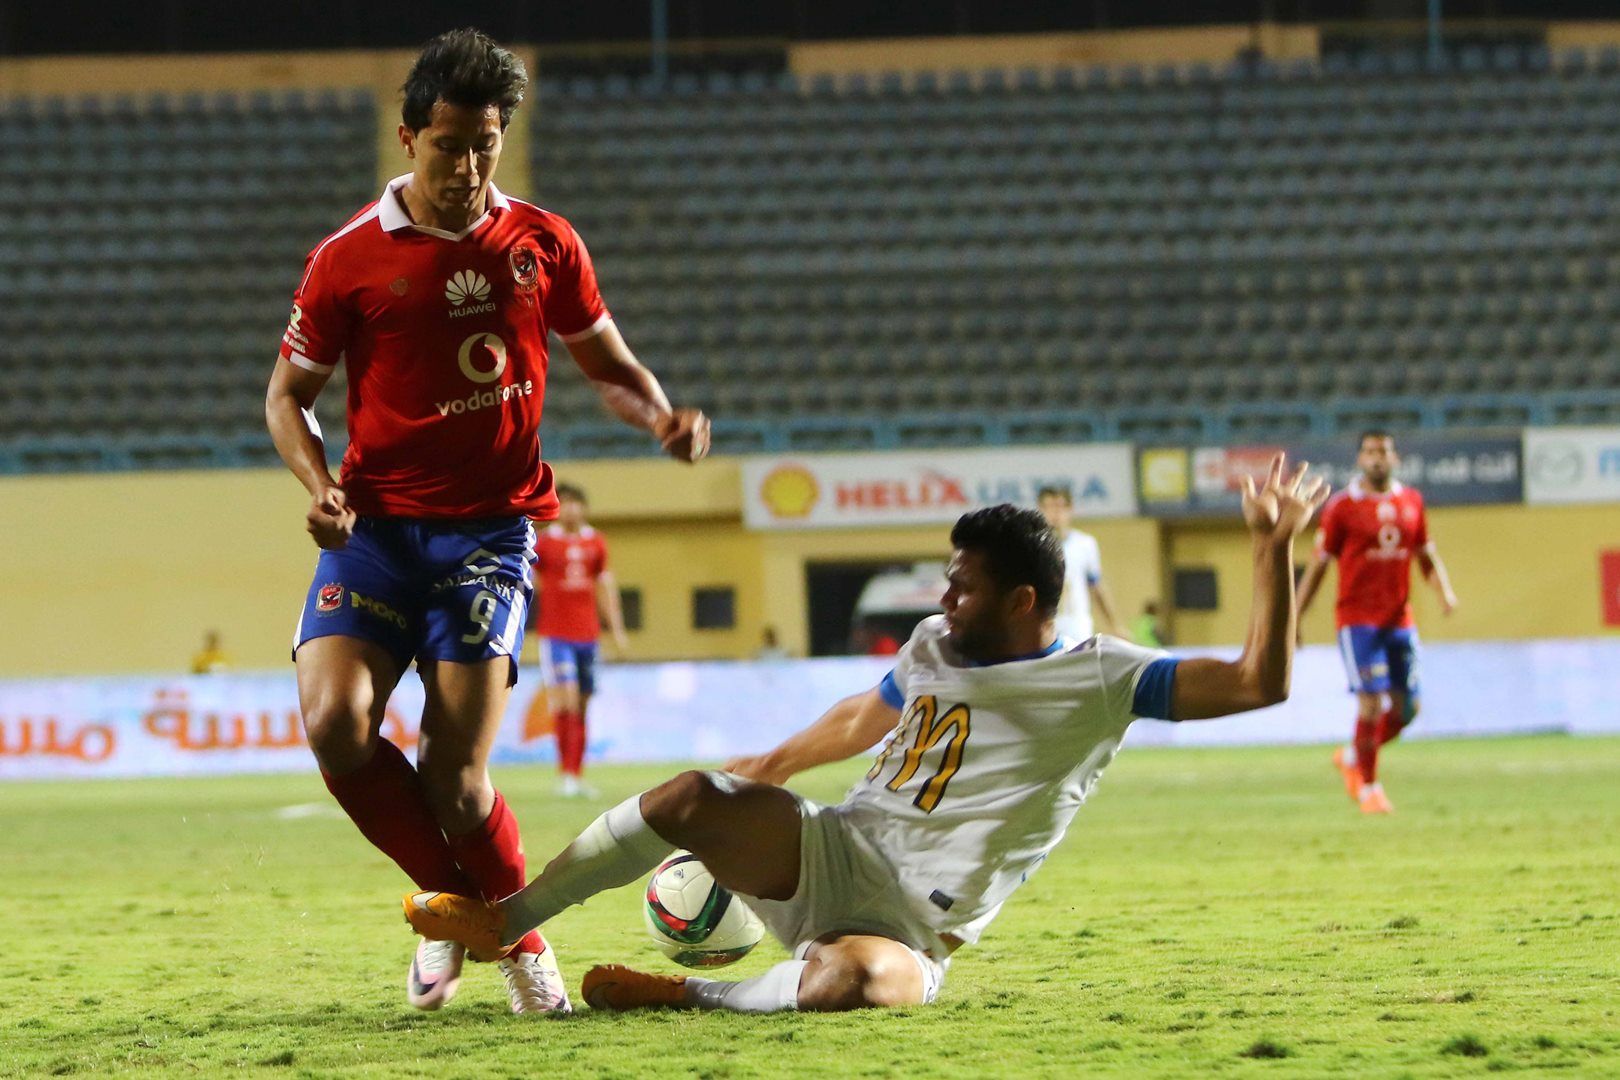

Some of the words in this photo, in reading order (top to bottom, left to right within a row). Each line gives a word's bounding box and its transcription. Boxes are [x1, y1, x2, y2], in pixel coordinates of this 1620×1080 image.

[449, 303, 496, 318] HUAWEI
[434, 379, 534, 416] vodafone
[835, 471, 968, 508] HELIX
[462, 590, 497, 644] 9
